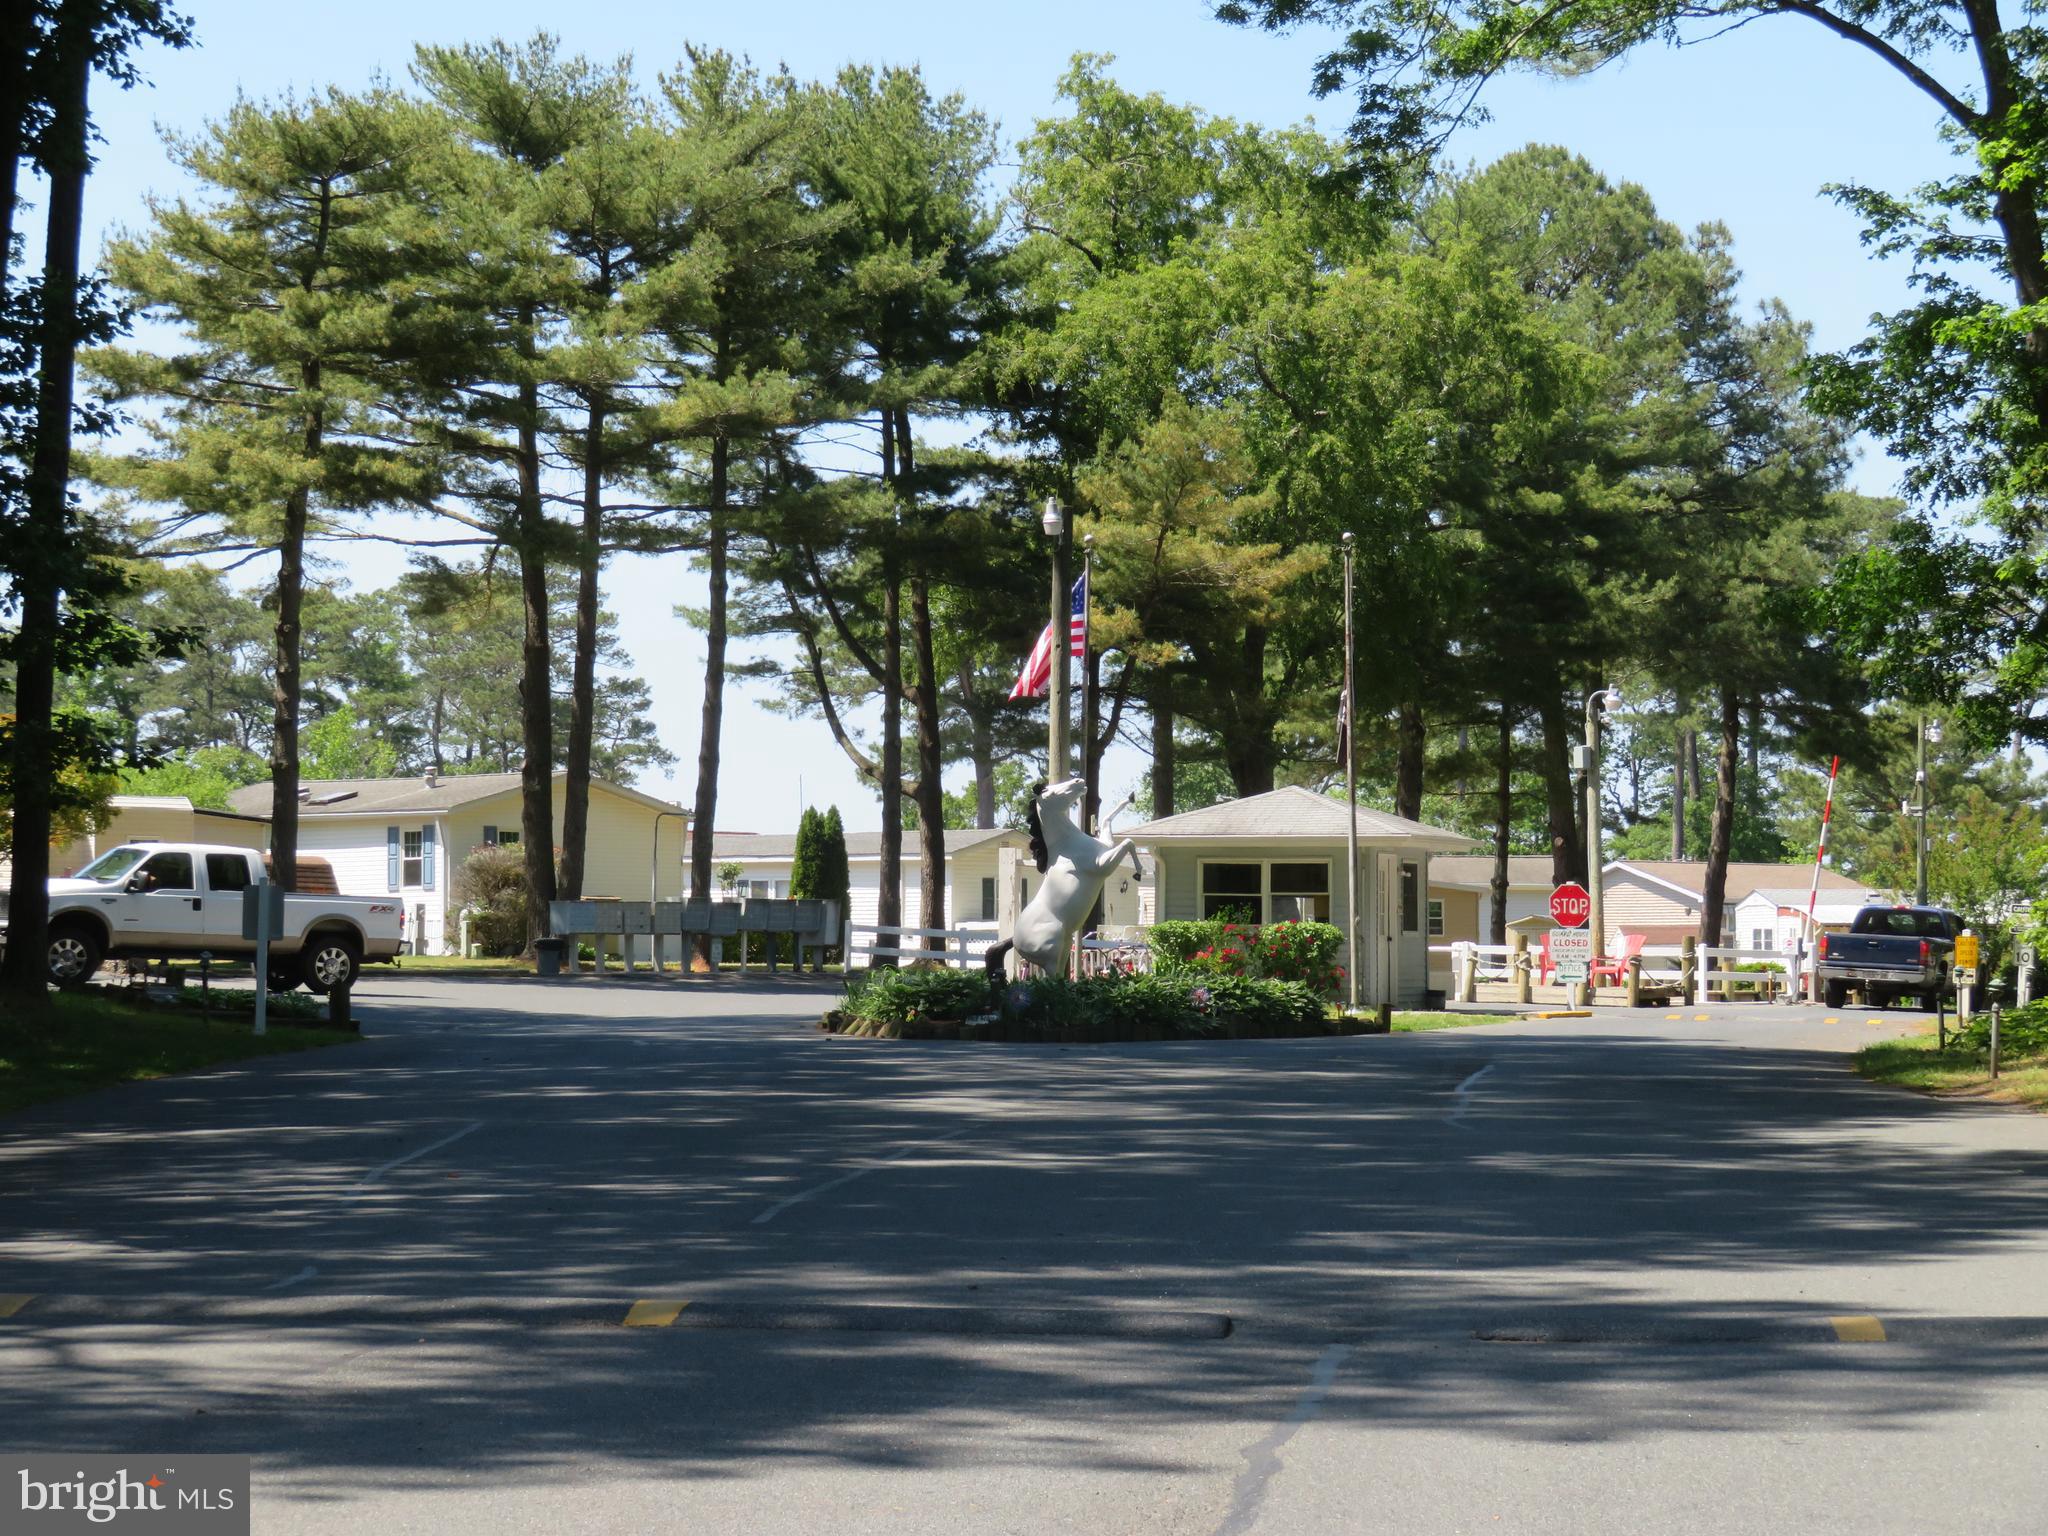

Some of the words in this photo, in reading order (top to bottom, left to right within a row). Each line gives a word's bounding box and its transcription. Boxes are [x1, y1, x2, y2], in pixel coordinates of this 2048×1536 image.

[1553, 898, 1588, 914] STOP
[1553, 939, 1588, 947] CLOSED
[2016, 952, 2030, 962] 10
